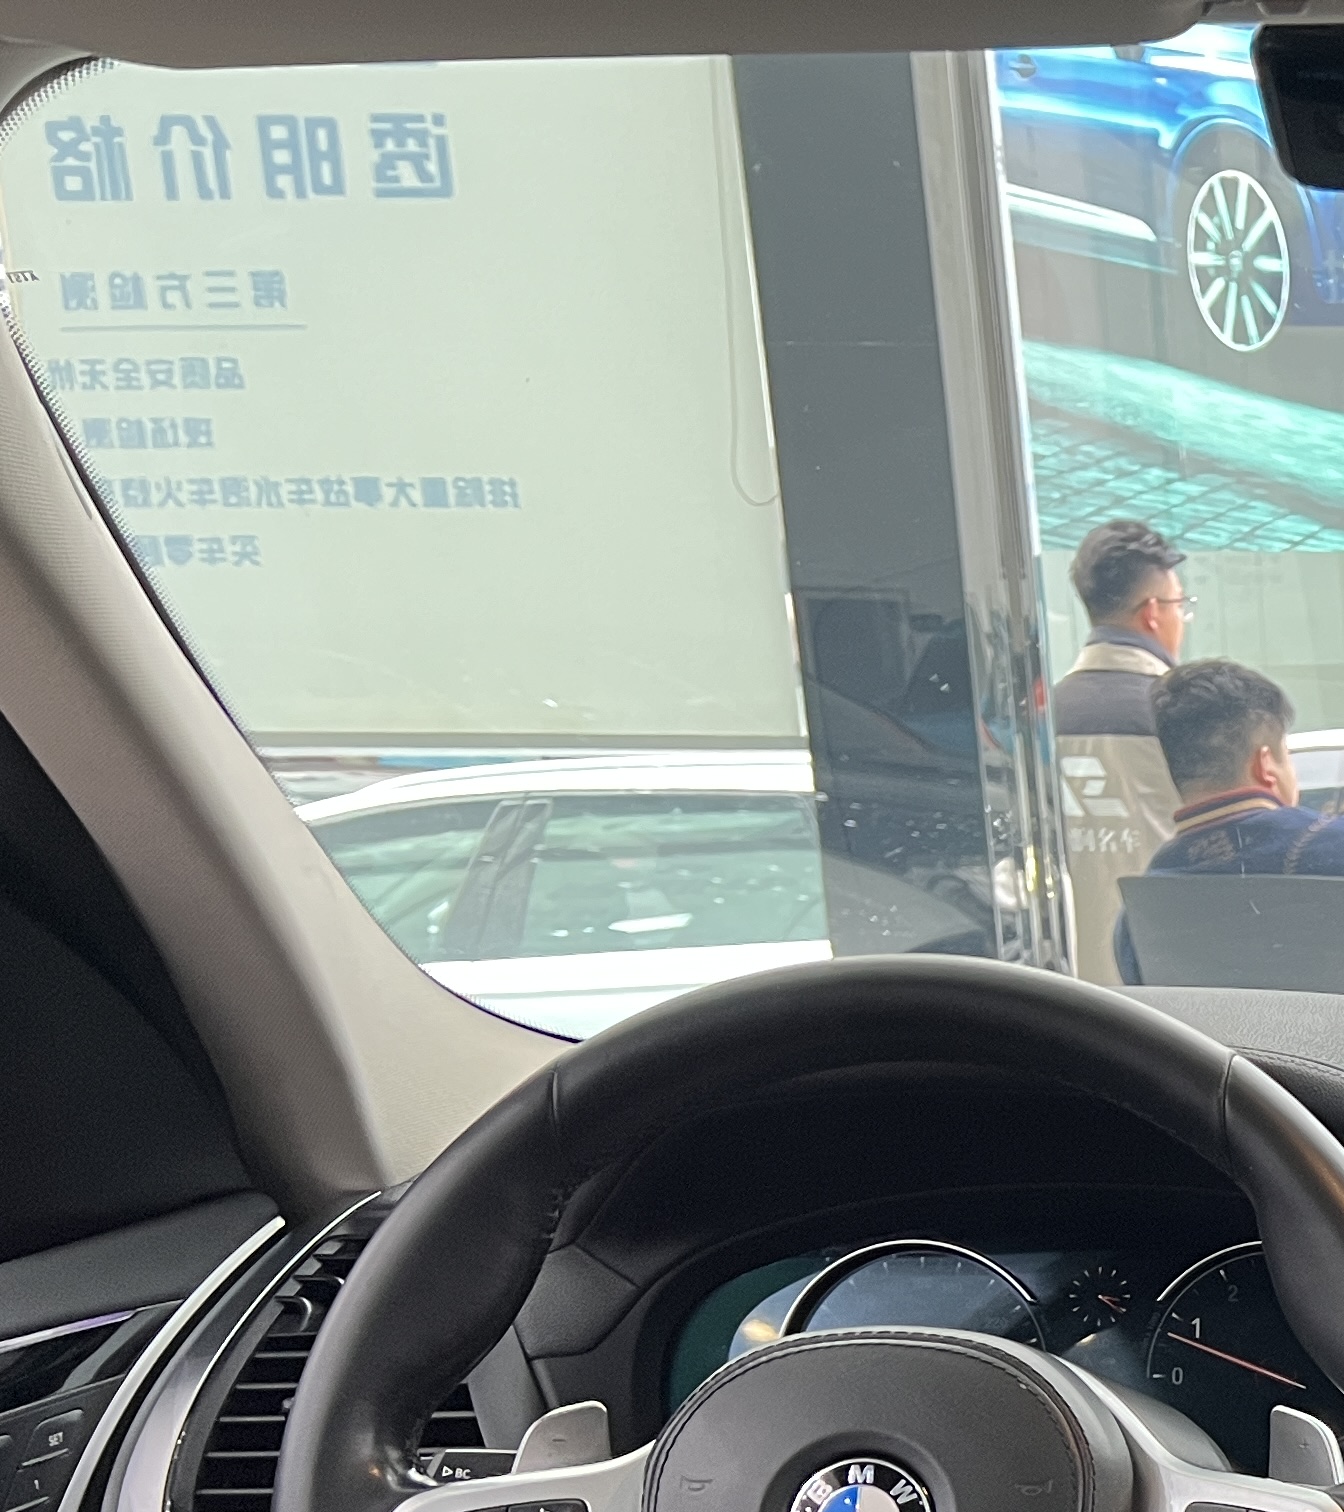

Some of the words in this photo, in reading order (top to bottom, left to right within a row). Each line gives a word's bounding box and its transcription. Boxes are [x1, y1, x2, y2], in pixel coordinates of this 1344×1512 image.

[1192, 1318, 1201, 1338] 1
[1171, 1368, 1183, 1385] 0
[455, 1468, 471, 1479] BC
[807, 1464, 918, 1505] BMW
